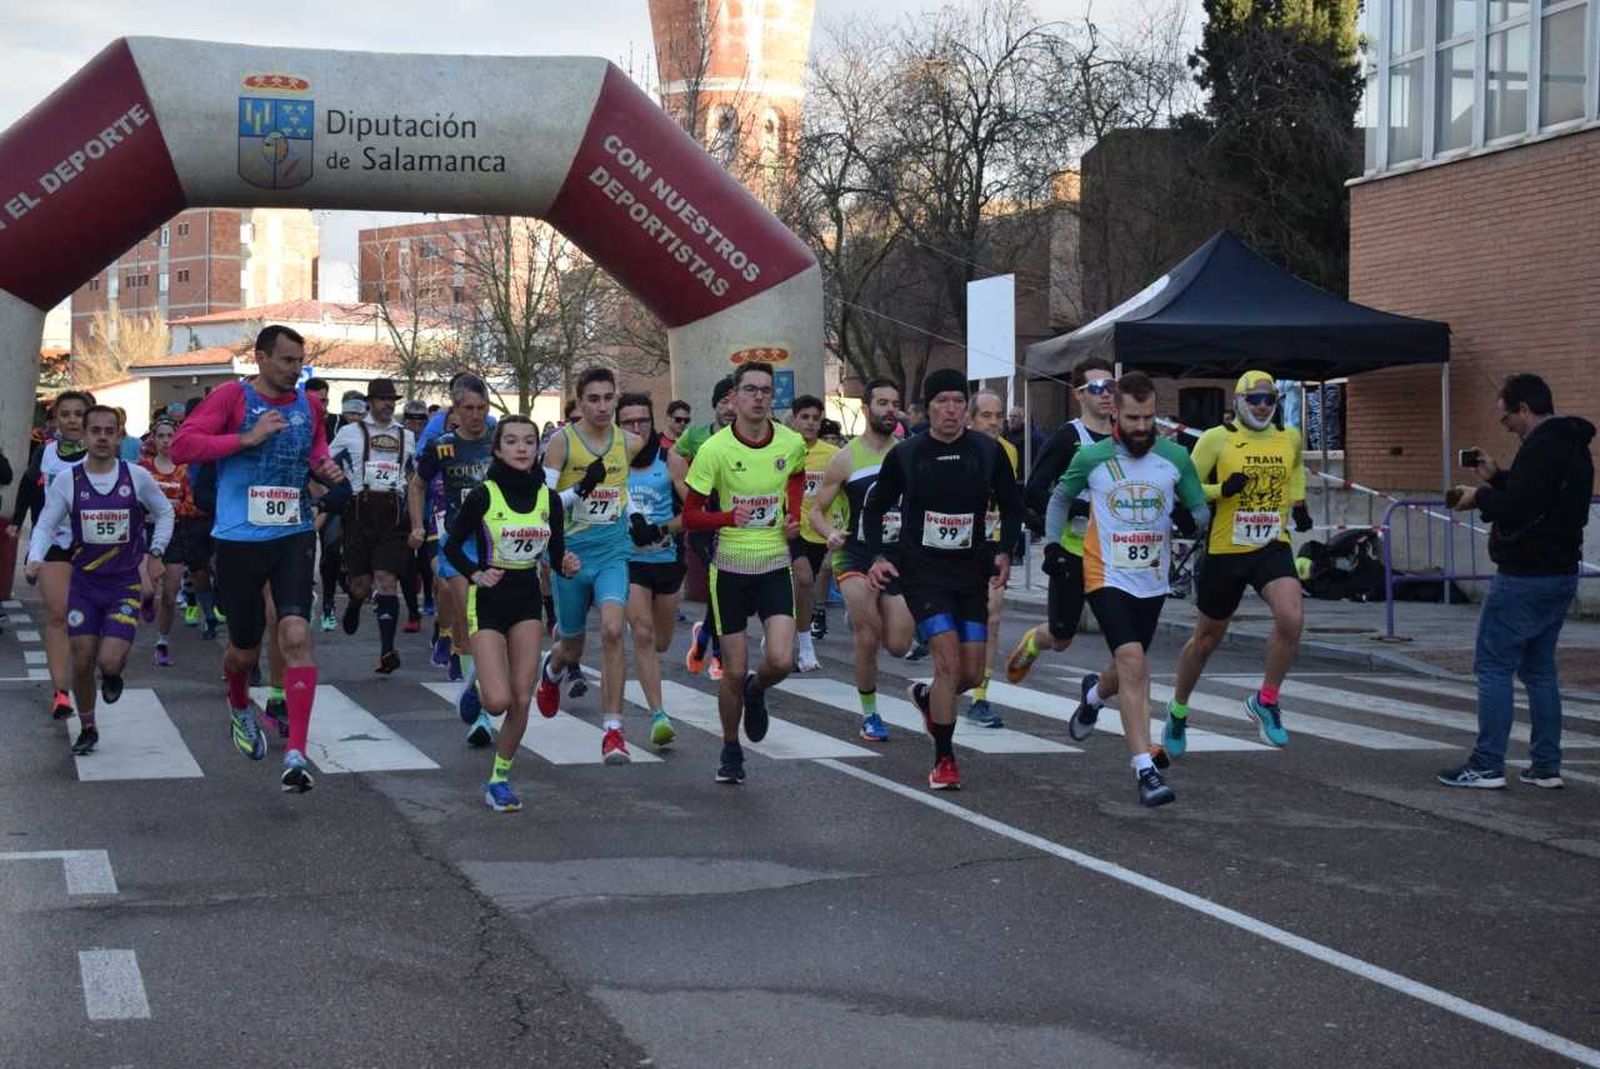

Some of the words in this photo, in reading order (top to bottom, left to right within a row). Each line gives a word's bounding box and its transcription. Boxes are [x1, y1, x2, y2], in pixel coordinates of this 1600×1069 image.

[327, 109, 477, 142] Diputación
[4, 192, 40, 220] EL
[39, 103, 150, 194] DEPORTE
[326, 150, 350, 170] de
[362, 146, 506, 172] Salamanca
[603, 134, 652, 182] CON
[650, 178, 760, 282] NUESTROS
[588, 165, 730, 297] DEPORTISTAS
[1245, 455, 1283, 465] TRAIN
[375, 469, 389, 480] 24
[266, 500, 286, 516] 80
[590, 501, 609, 515] 27
[97, 522, 116, 535] 55
[939, 527, 958, 541] 99
[1246, 525, 1272, 538] 117
[514, 539, 534, 553] 76
[1128, 545, 1149, 560] 83
